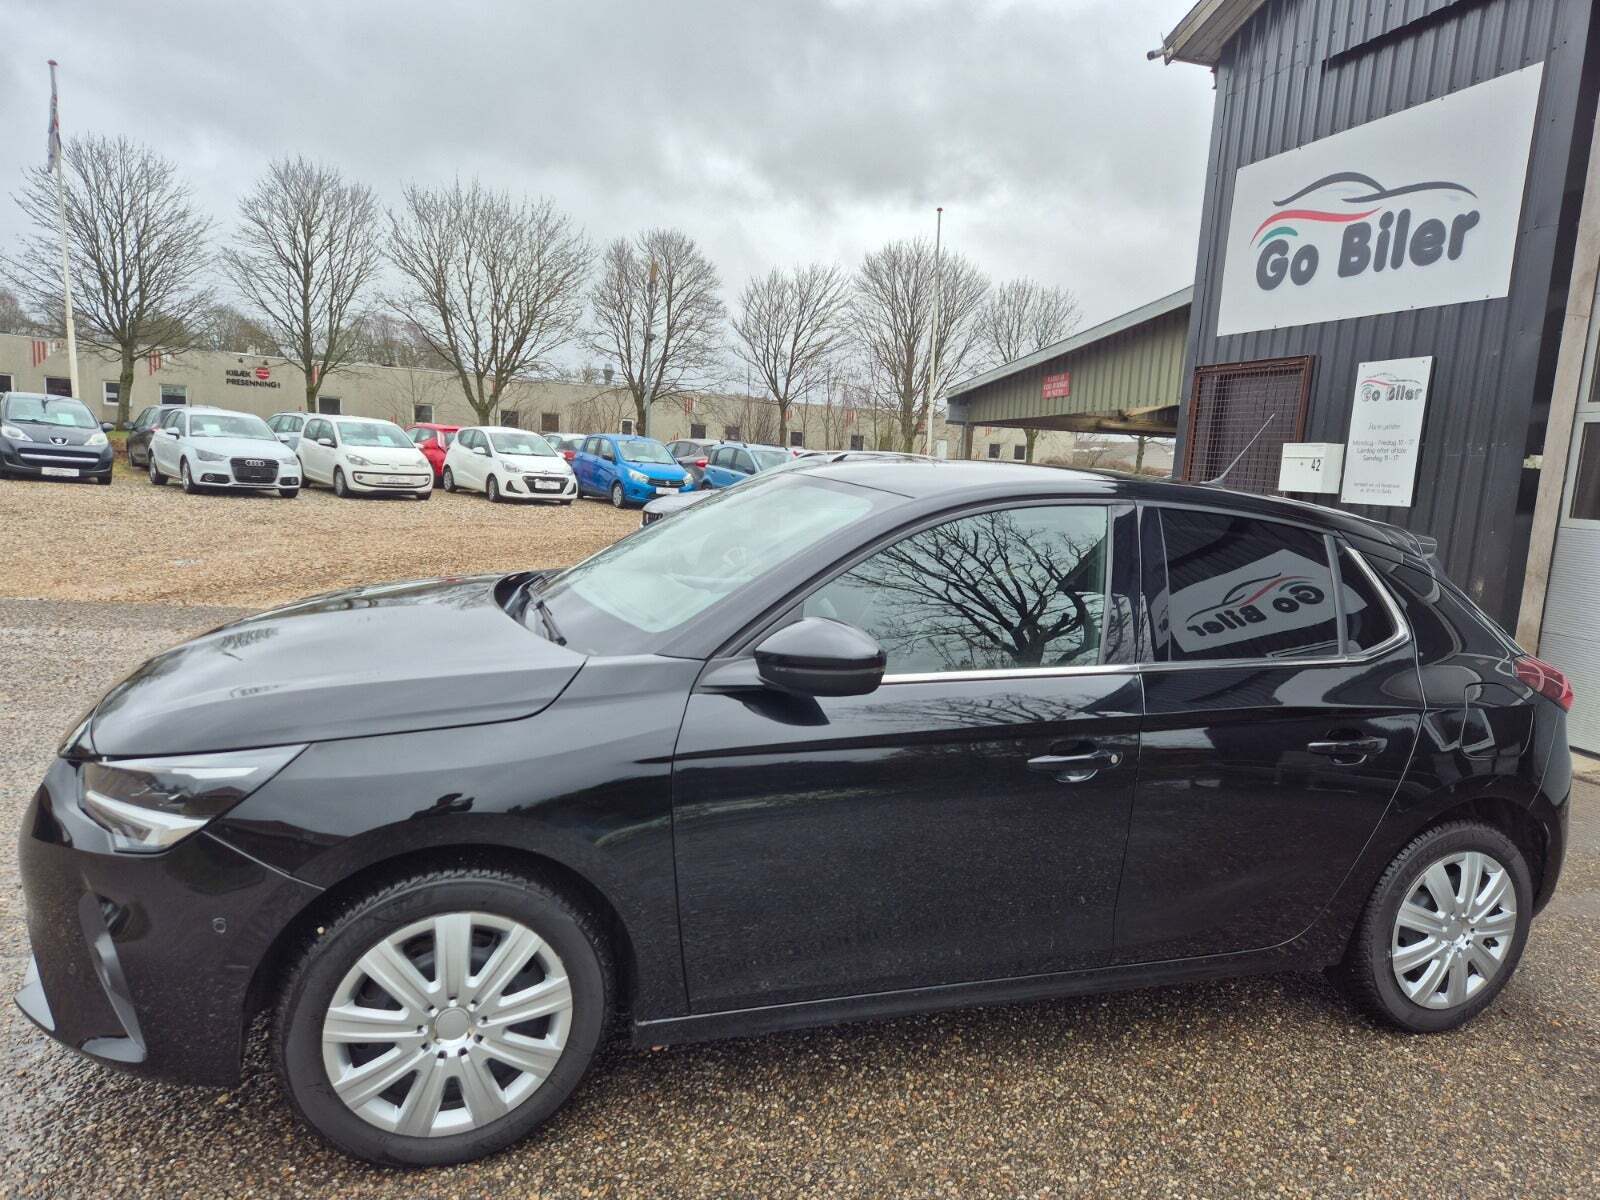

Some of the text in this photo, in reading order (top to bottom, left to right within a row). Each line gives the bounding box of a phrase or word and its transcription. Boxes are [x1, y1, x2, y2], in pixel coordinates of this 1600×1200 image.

[1256, 208, 1481, 291] Go Biler
[1311, 458, 1321, 472] 42
